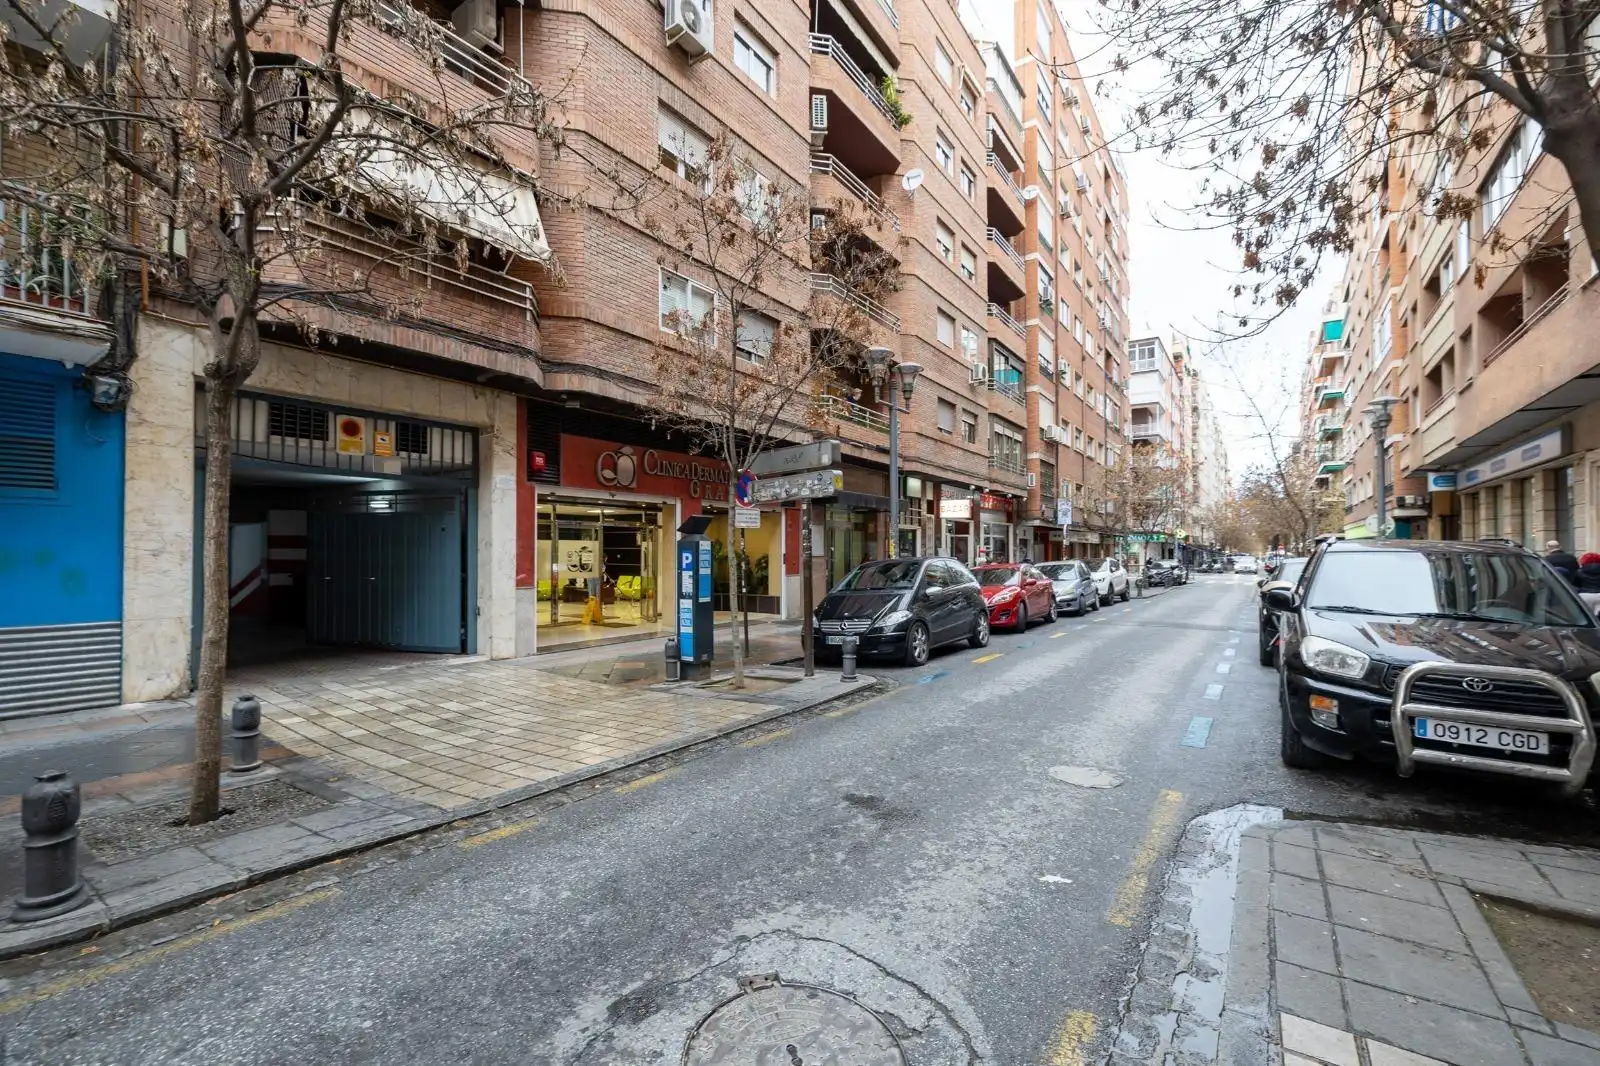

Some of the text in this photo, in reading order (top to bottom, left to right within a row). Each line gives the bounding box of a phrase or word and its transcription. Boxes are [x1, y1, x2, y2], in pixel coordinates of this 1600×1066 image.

[691, 462, 730, 484] DERMAT
[690, 479, 724, 500] GRA
[682, 552, 693, 569] P
[1433, 723, 1540, 750] 0912 CGD
